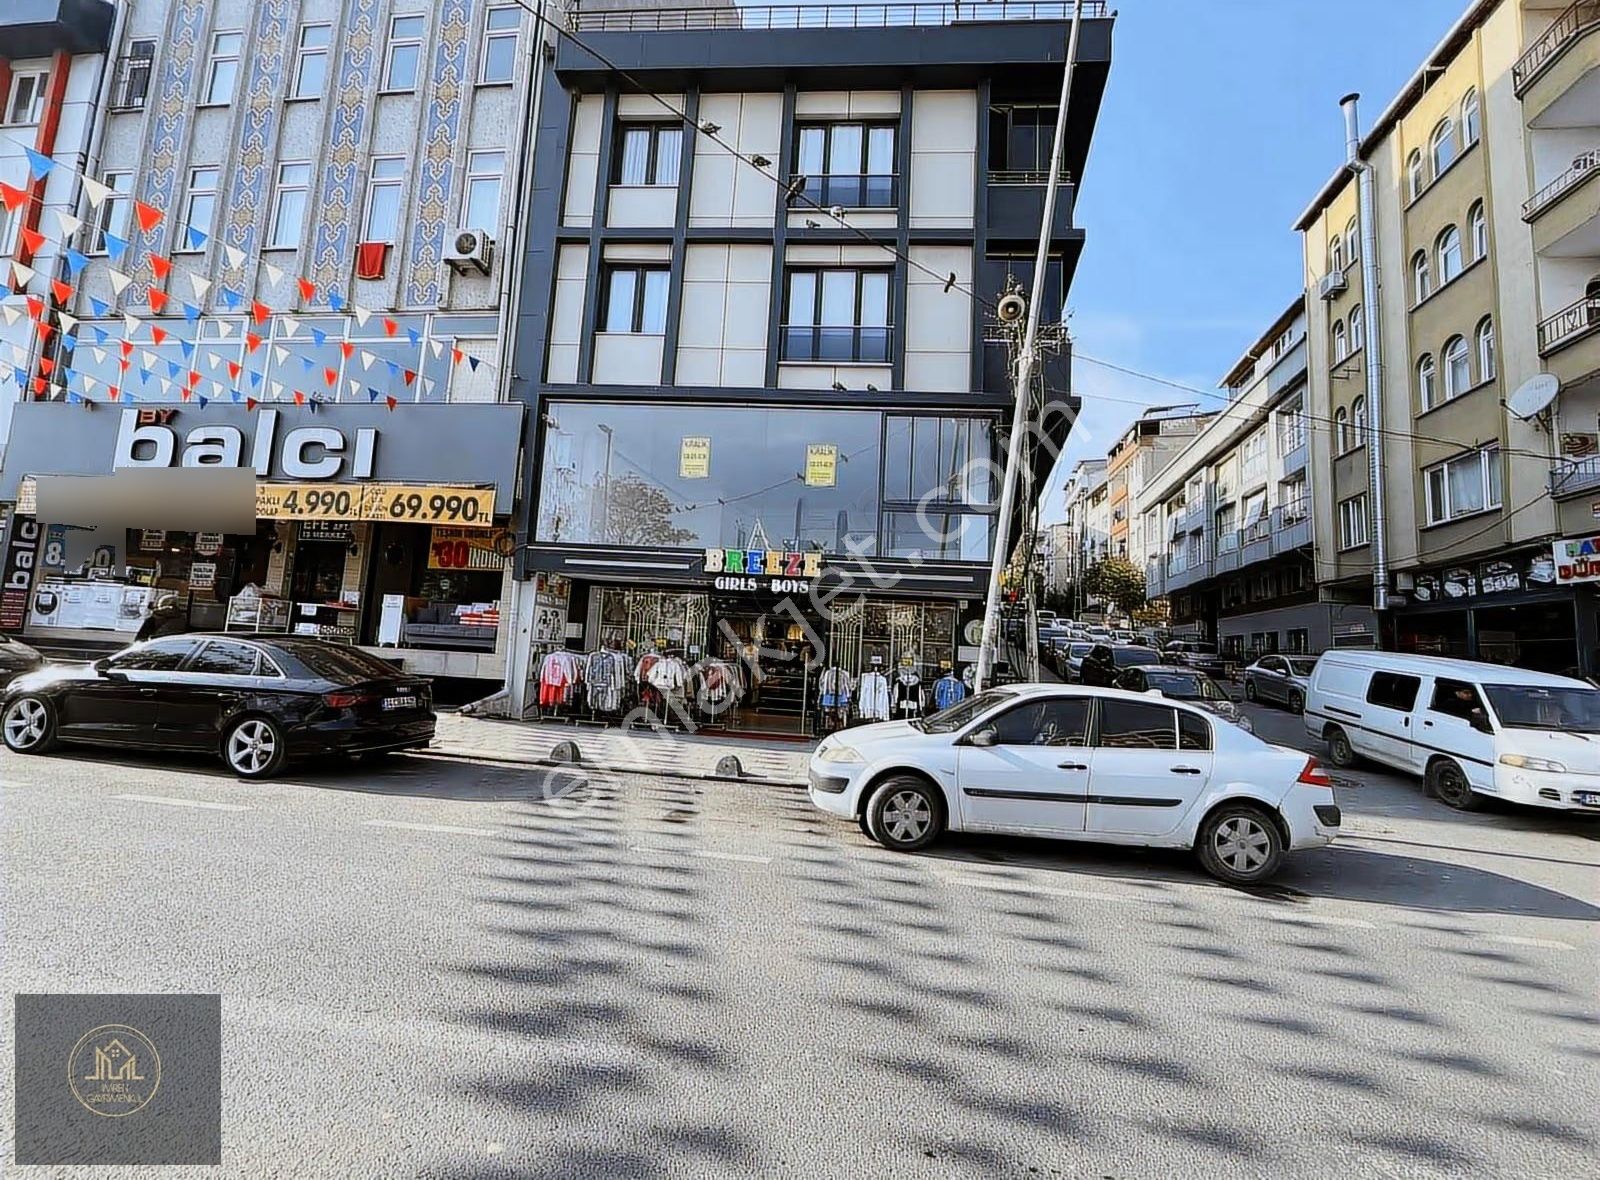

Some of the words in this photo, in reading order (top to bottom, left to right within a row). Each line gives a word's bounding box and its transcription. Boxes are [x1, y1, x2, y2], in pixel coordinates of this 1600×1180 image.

[139, 409, 177, 424] BY
[112, 408, 376, 478] balcı
[283, 490, 351, 515] 4.990
[390, 493, 479, 521] 69.990
[704, 548, 822, 577] BREEZE
[715, 576, 757, 591] GIRLS
[771, 577, 809, 593] BOYS
